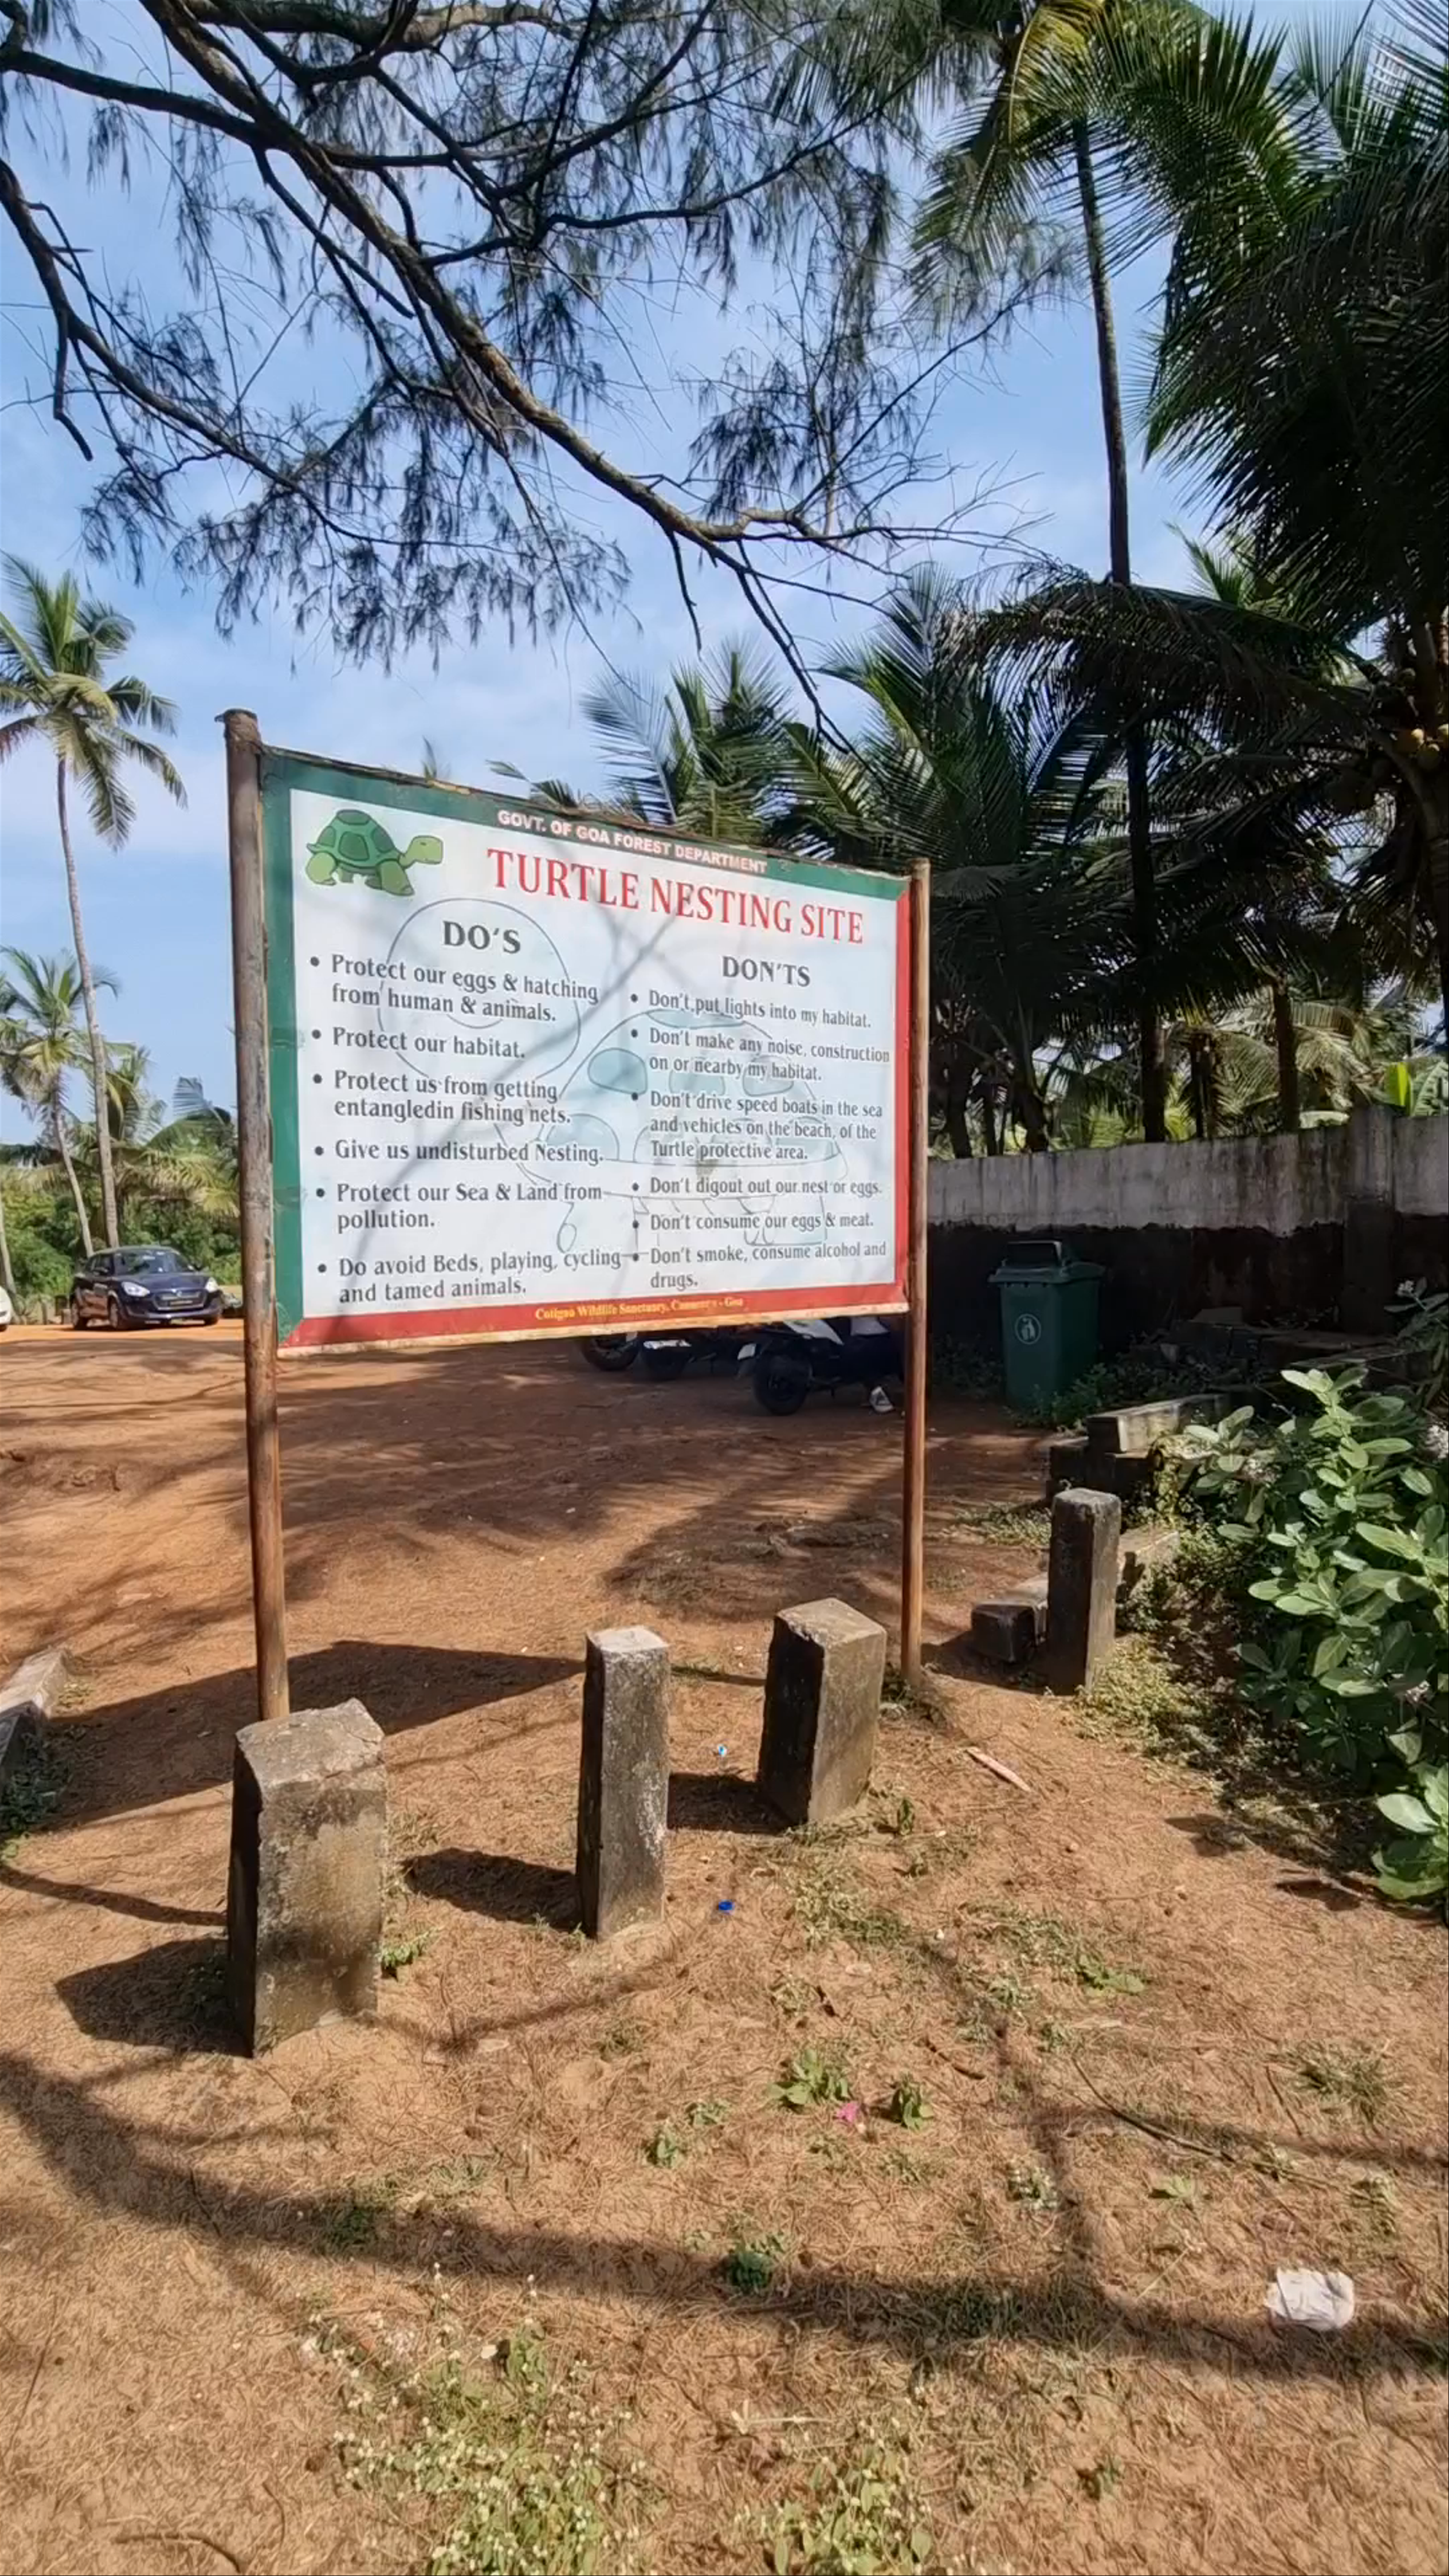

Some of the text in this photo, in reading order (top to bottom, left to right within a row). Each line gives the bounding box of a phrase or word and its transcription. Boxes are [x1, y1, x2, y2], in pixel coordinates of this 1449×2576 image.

[498, 810, 768, 873] GOVT. OF GOA FOREST DEPARTMENT
[488, 848, 863, 943] TURTLE NESTING SITE
[443, 921, 521, 954] DO'S
[332, 954, 599, 1005] Protect our eggs & hatching
[723, 956, 811, 987] DON'TS
[332, 983, 555, 1021] from human & animals.
[649, 990, 871, 1027] Don't put lights into my habitat.
[333, 1027, 525, 1058] Protect our habitat.
[650, 1027, 689, 1046] Don't
[696, 1033, 734, 1050] make
[740, 1038, 763, 1055] any
[811, 1044, 889, 1063] construction
[650, 1057, 821, 1080] on or nearby my habitat.
[335, 1070, 557, 1103] Protect us from getting
[335, 1099, 571, 1126] entangledin fishing nets.
[651, 1091, 882, 1117] Don't drive speed boats in the sea
[651, 1116, 678, 1132] and
[683, 1117, 741, 1133] vehicles
[746, 1123, 763, 1135] on
[769, 1121, 790, 1136] the
[840, 1124, 853, 1138] of
[857, 1124, 876, 1139] the
[335, 1139, 603, 1166] Give us undisturbed Nesting.
[651, 1140, 807, 1162] Turtle protective area.
[337, 1183, 601, 1202] Protect our Sea & Land from
[651, 1177, 882, 1198] Don't digout out our nest or eggs.
[338, 1210, 434, 1234] pollution.
[651, 1212, 873, 1232] Don't consume our eggs & meat.
[340, 1258, 366, 1276] Do
[374, 1255, 426, 1275] avoid
[434, 1253, 483, 1273] Beds,
[564, 1249, 621, 1271] cycling
[651, 1241, 886, 1264] Don't smoke, consume alcohol and
[340, 1277, 526, 1303] and tamed animals.
[651, 1271, 698, 1290] drugs.
[577, 1304, 618, 1316] Wildlife
